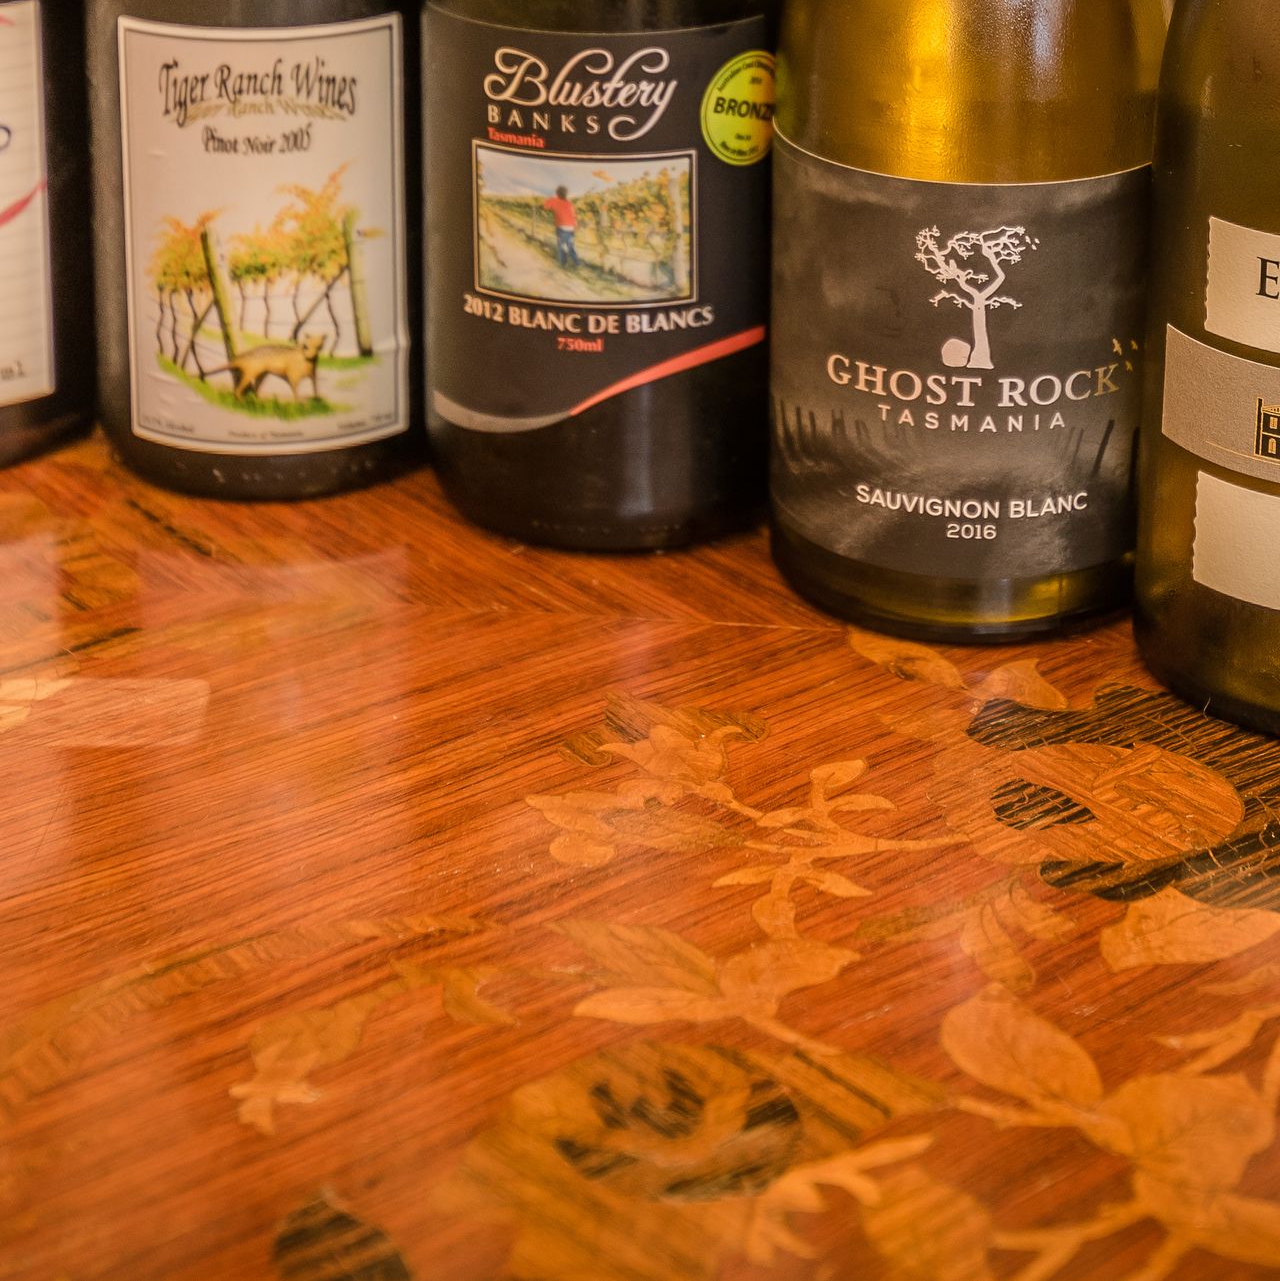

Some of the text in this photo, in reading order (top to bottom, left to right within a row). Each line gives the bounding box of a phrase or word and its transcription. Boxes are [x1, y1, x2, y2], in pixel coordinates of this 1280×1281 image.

[158, 56, 357, 128] Tiger Ranch Wines
[483, 45, 678, 142] Blustery
[487, 104, 601, 135] BANKS
[713, 96, 776, 122] BRONZ
[202, 125, 238, 154] Pinot
[243, 135, 276, 155] Noir
[487, 126, 545, 149] Tasmania
[463, 293, 715, 335] 2012 BLANC DE BLANCS
[556, 336, 605, 354] 750ml
[826, 354, 1121, 409] GHOST ROCK
[877, 403, 1066, 434] TASMANIA
[856, 484, 1089, 520] SAUVIGNON BLANC
[945, 523, 998, 541] 2016
